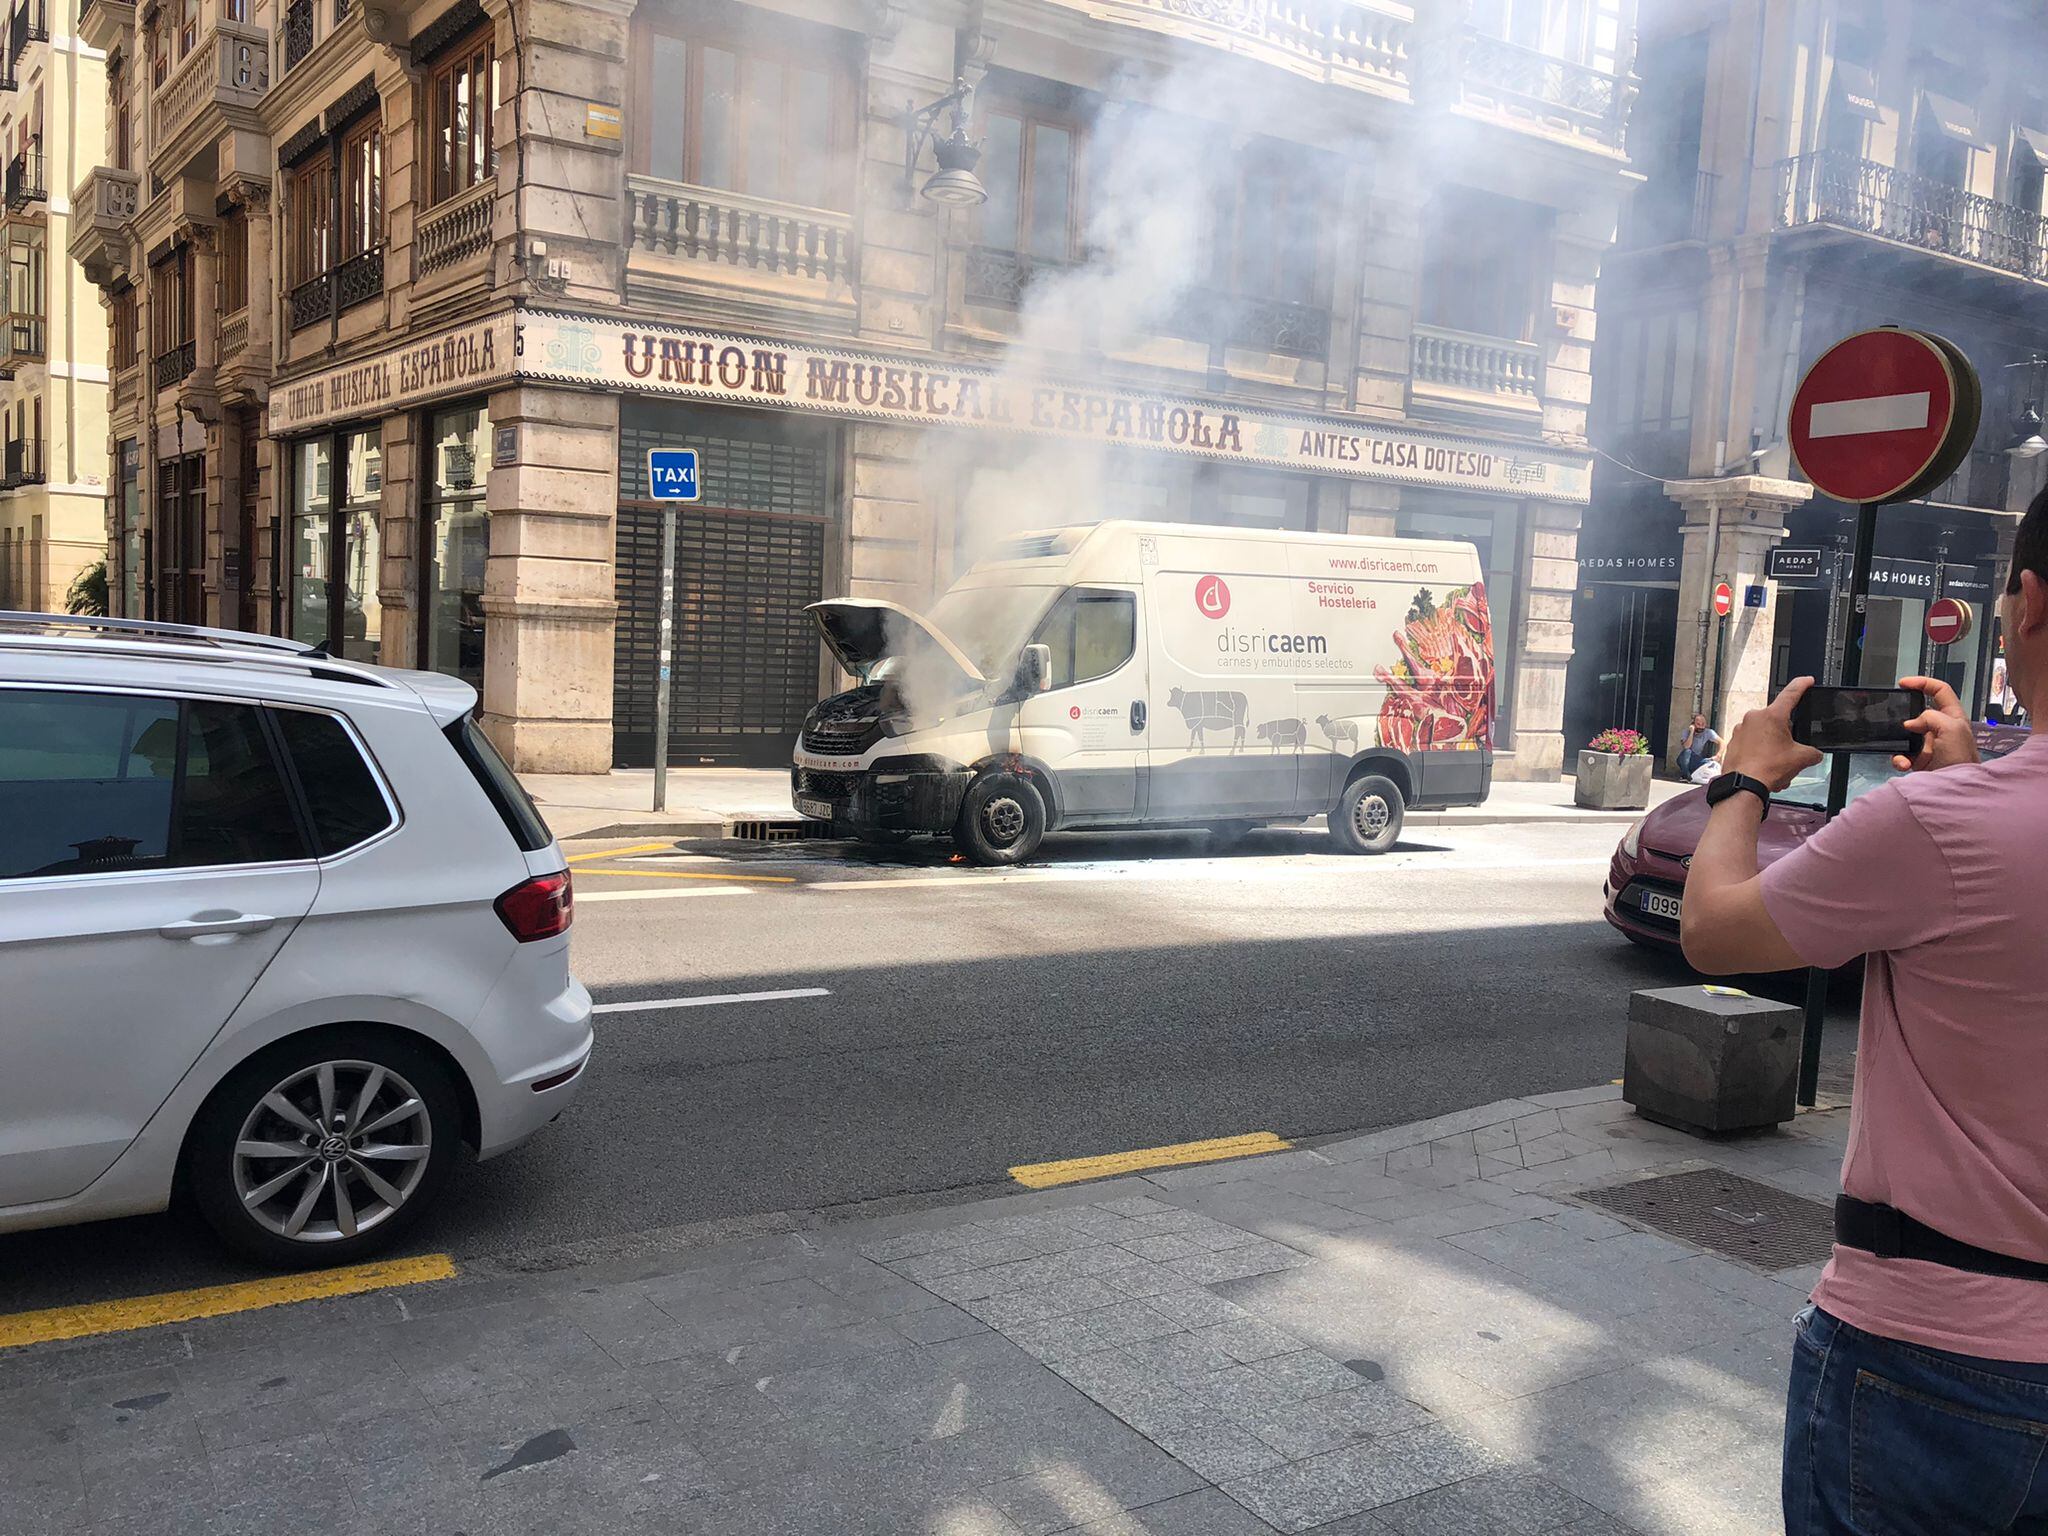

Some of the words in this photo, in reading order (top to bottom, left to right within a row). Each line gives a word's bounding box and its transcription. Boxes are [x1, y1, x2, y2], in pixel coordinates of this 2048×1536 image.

[289, 382, 324, 421] UNION
[331, 362, 391, 411] MUSICAL
[400, 327, 496, 394] ESPAÑOLA
[622, 332, 788, 396] UNION
[805, 356, 1014, 422] MUSICAL
[1300, 430, 1360, 462] ANTES
[653, 467, 695, 483] TAXI
[1328, 557, 1439, 573] www.disricaem.com
[1579, 557, 1623, 568] AEDAS
[1627, 557, 1676, 568] HOMES
[1891, 572, 1931, 587] HOMES
[1308, 581, 1354, 595] Servicio
[1217, 626, 1328, 654] disricaem
[1217, 657, 1251, 668] carnes
[1262, 656, 1312, 668] embutidos
[1315, 657, 1354, 669] selectos
[1651, 895, 1682, 916] 099
